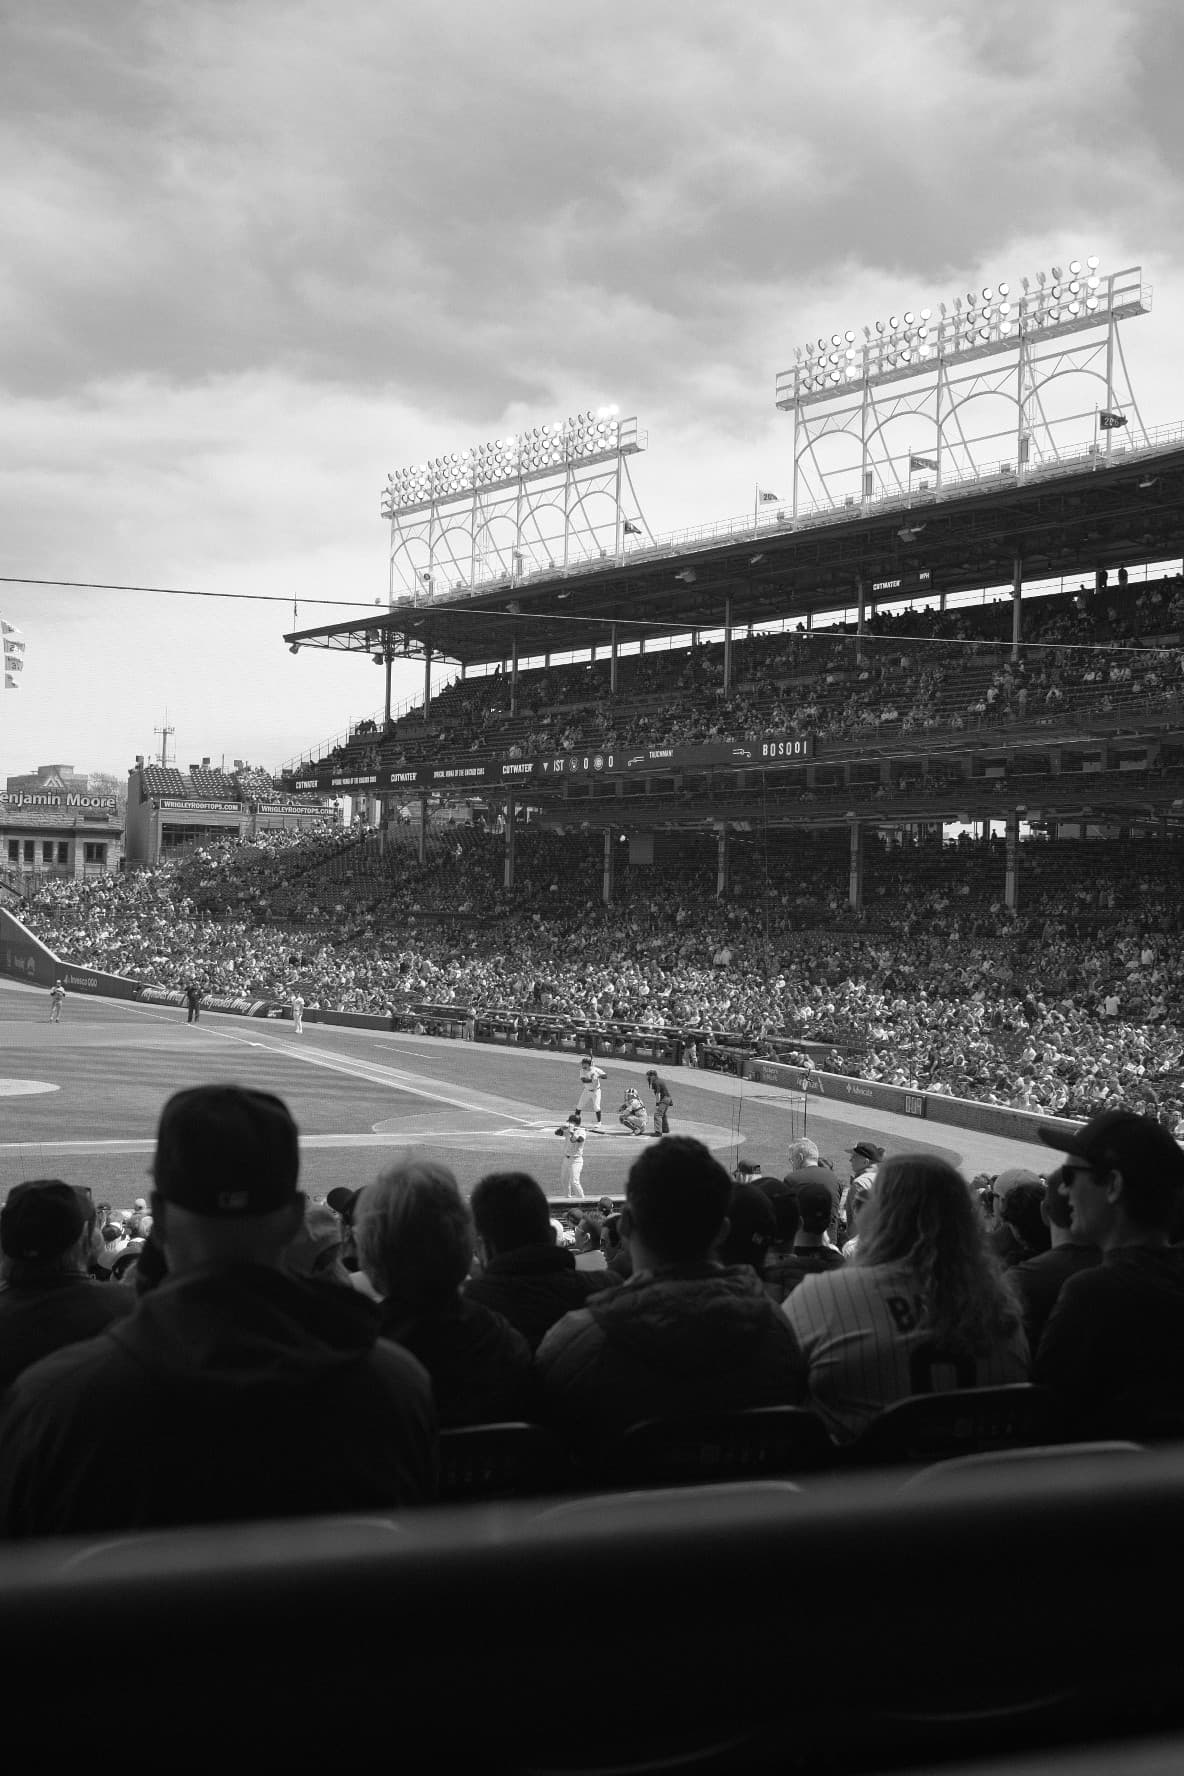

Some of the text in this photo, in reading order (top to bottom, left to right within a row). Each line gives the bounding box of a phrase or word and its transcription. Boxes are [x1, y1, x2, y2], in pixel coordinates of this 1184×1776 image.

[583, 757, 589, 770] 0
[608, 755, 614, 768] 0
[502, 763, 534, 775] CUTWATER
[390, 772, 418, 783] CUTWATER
[66, 793, 117, 808] Moore
[163, 800, 239, 812] WRIGLEYROOFTOPS.COM
